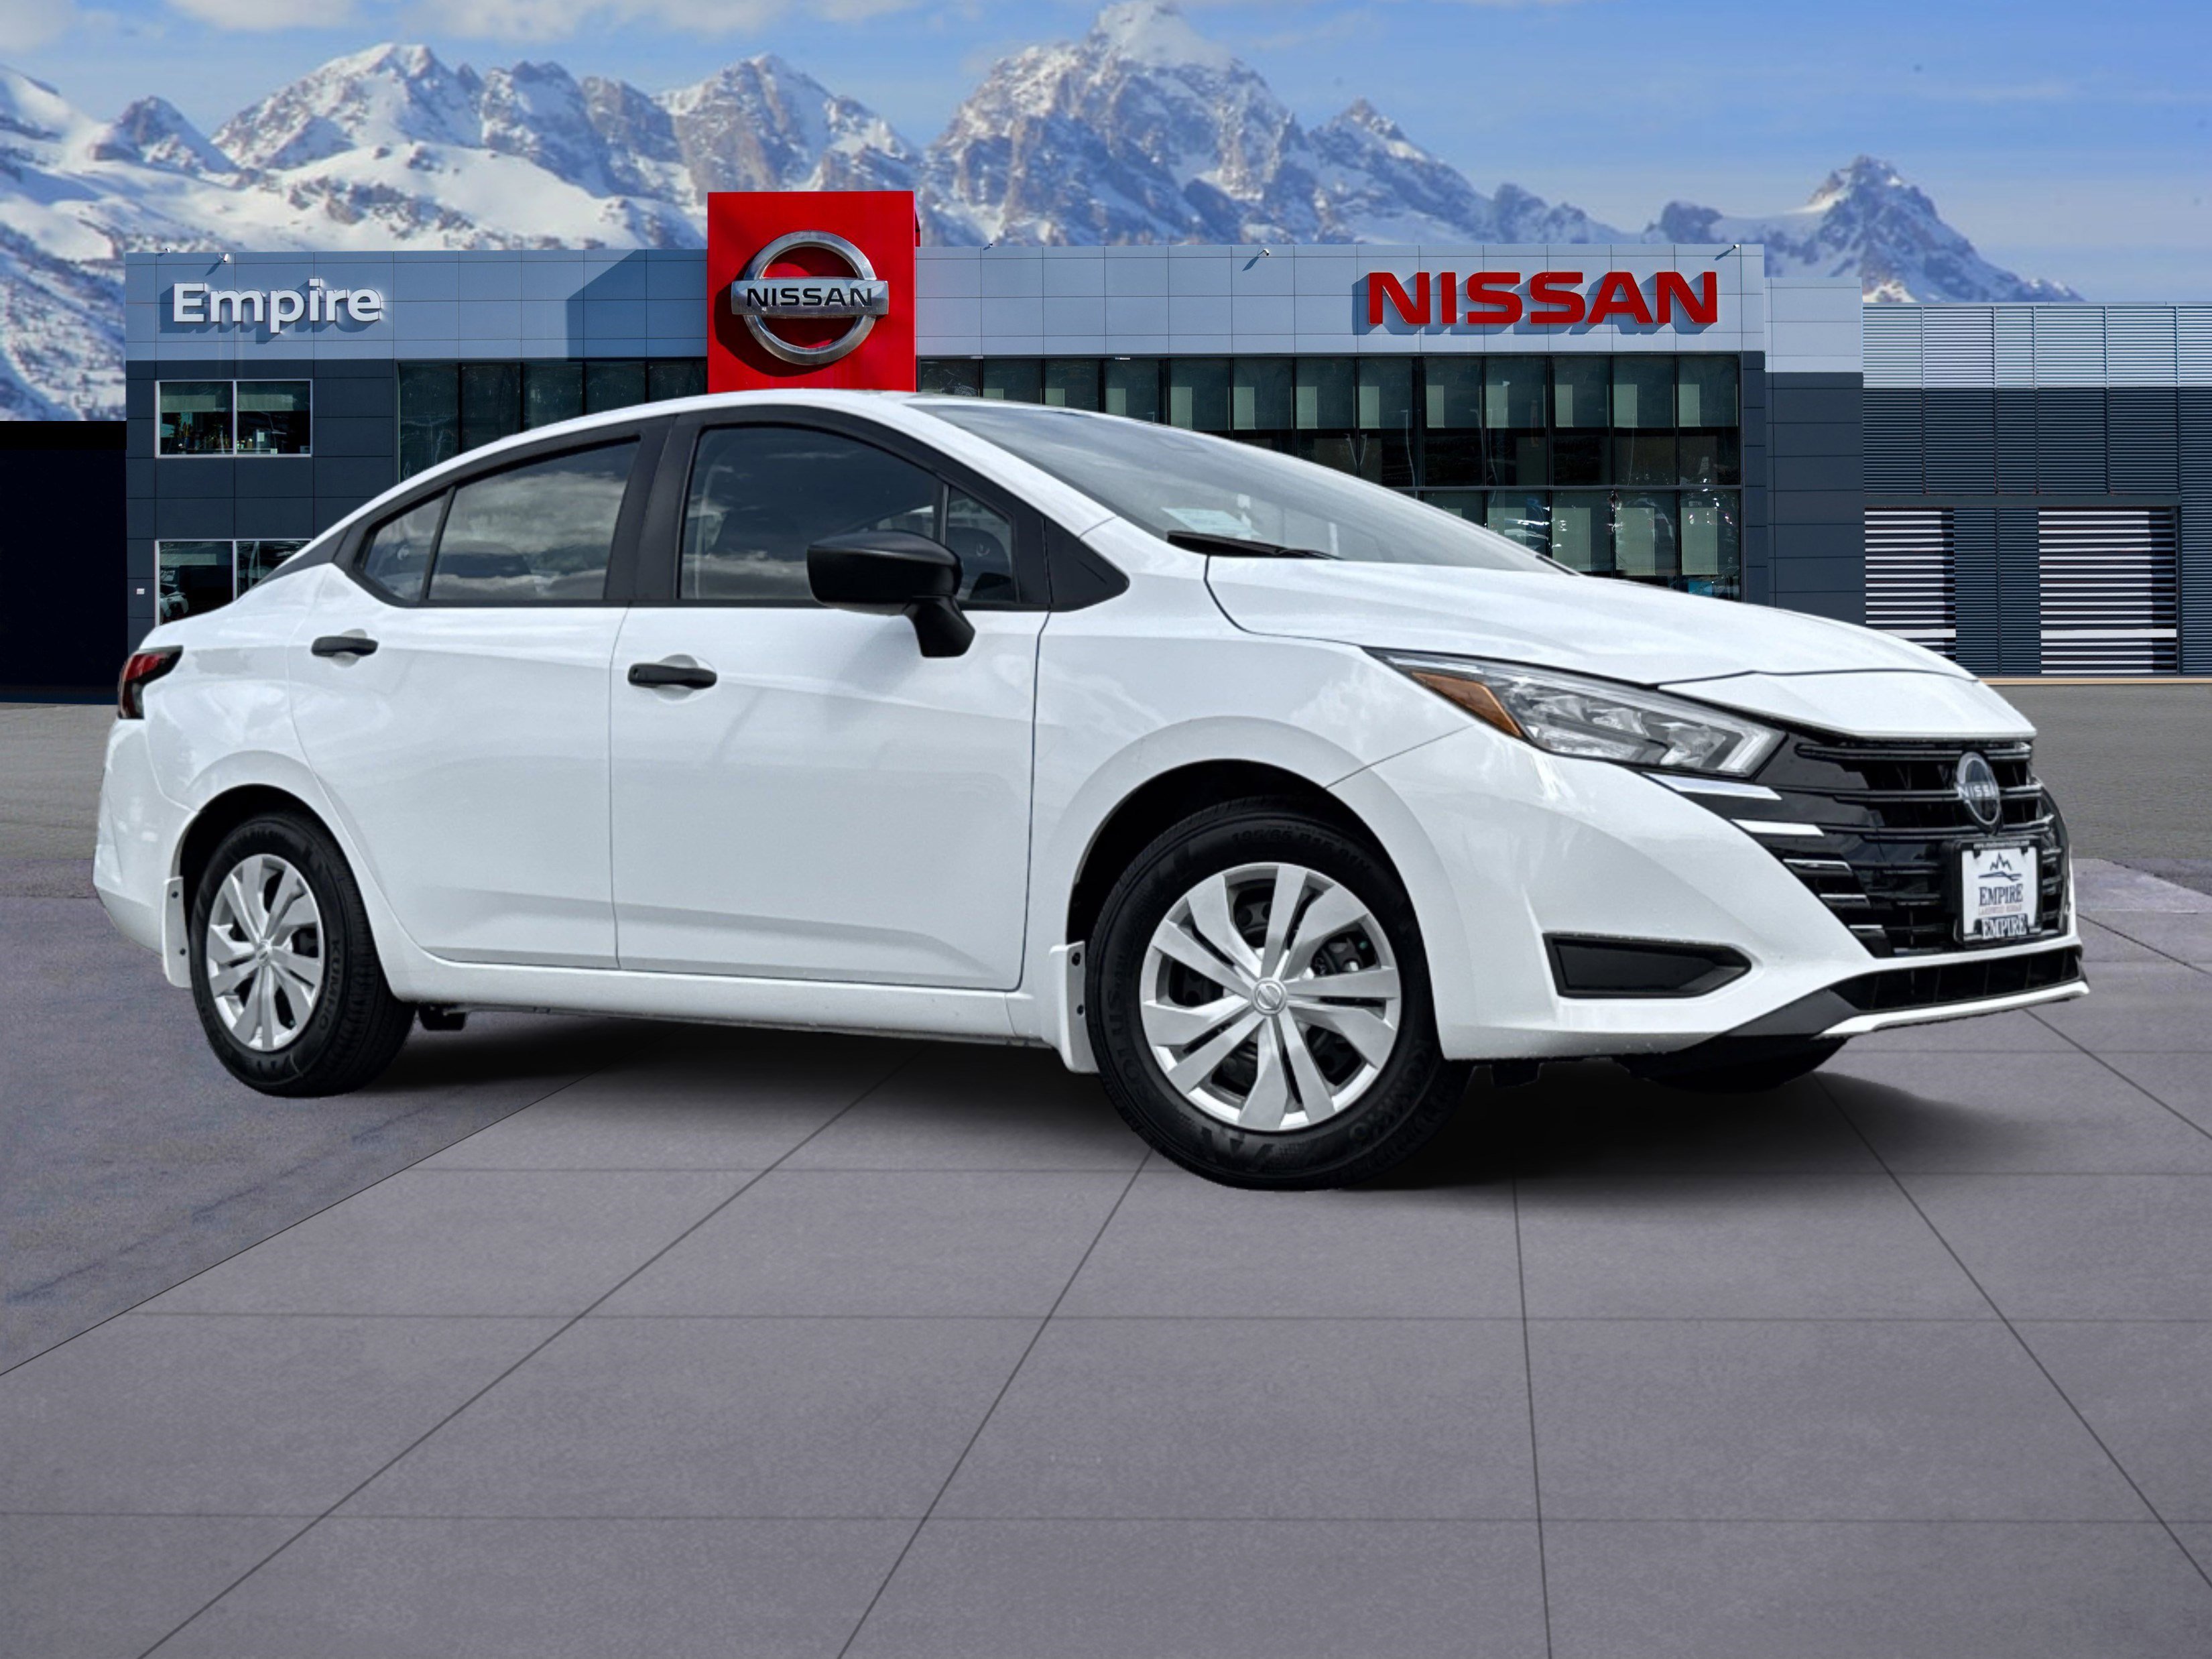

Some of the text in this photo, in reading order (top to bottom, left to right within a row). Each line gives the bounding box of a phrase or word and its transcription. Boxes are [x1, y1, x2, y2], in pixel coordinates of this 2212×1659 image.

[173, 278, 381, 333] Empire
[746, 288, 872, 307] NISSAN
[1368, 271, 1718, 326] NISSAN
[1957, 785, 1996, 800] NISS
[1979, 883, 2024, 906] EMPIRE
[1982, 914, 2027, 939] EMPIRE
[318, 938, 341, 1031] KUMHO
